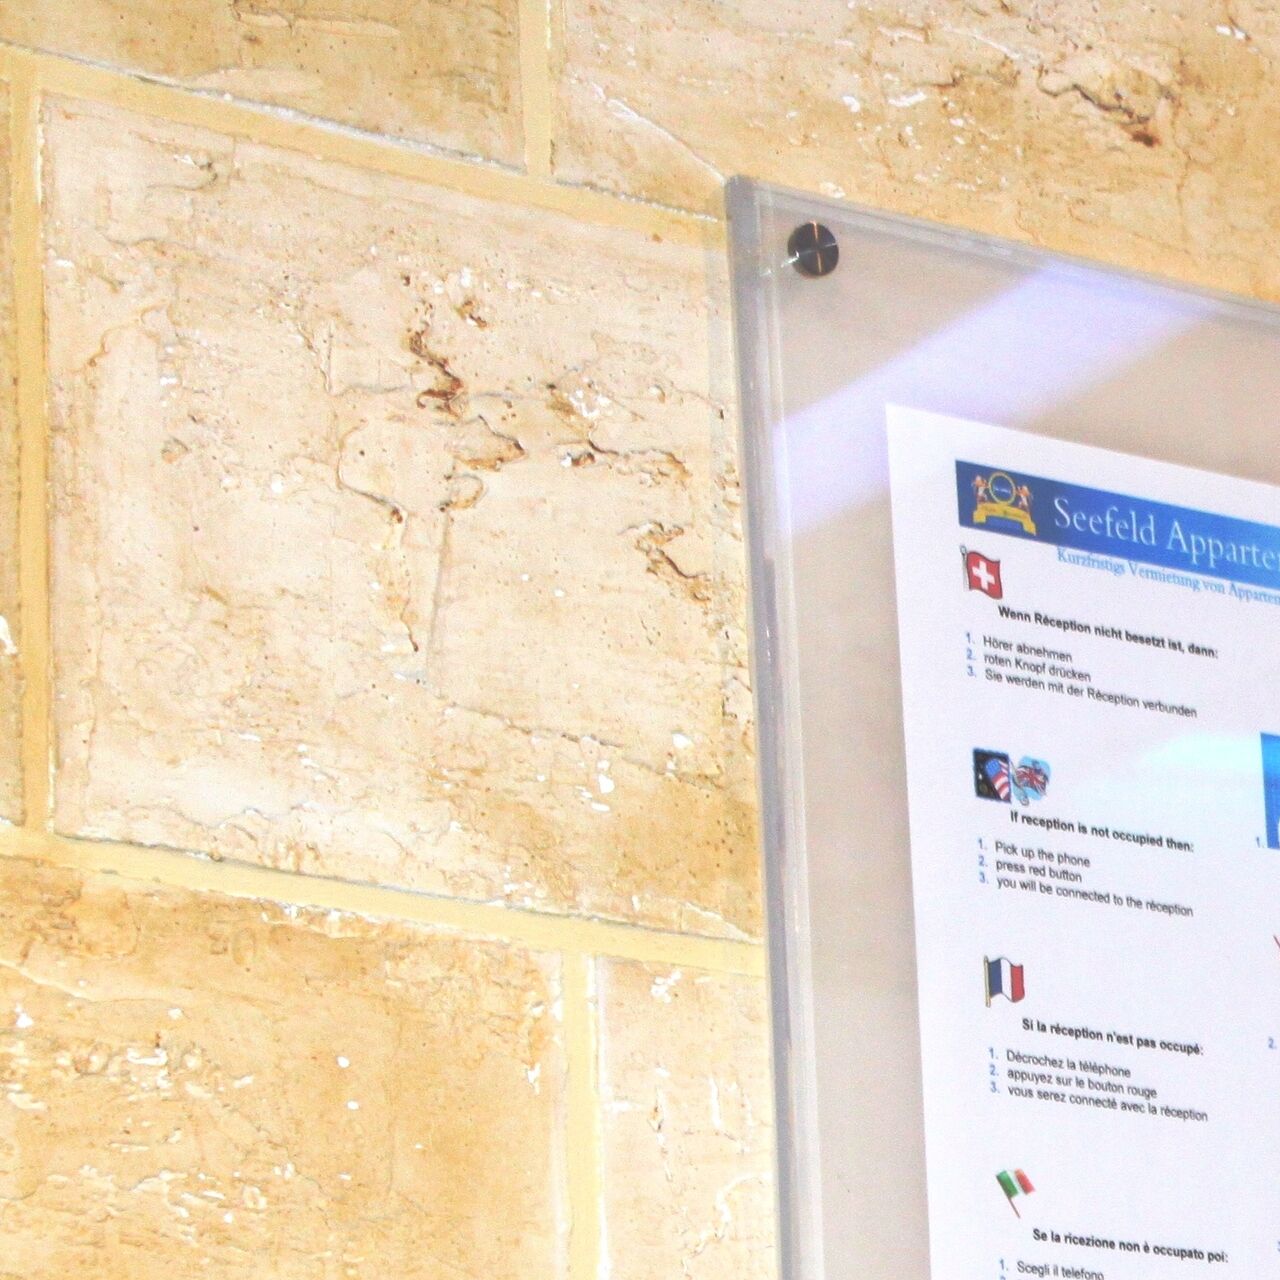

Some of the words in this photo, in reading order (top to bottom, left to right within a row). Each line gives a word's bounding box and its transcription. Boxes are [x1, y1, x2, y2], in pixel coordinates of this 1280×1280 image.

[1054, 496, 1156, 546] Seefeld
[966, 632, 975, 645] 1.
[983, 635, 1013, 652] Hörer
[1017, 642, 1072, 663] abnehmen
[998, 606, 1031, 623] Wenn
[1095, 626, 1123, 640] nicht
[1125, 631, 1165, 649] besetzt
[1168, 640, 1185, 653] ist,
[1188, 643, 1219, 659] dann:
[966, 649, 976, 661] 2.
[984, 654, 1012, 668] roten
[1015, 658, 1046, 676] Knopf
[1048, 665, 1091, 683] drücken
[967, 666, 976, 678] 3.
[985, 669, 1003, 683] Sie
[1006, 675, 1045, 690] werden
[1048, 682, 1064, 694] mit
[1067, 685, 1084, 698] der
[1142, 700, 1198, 719] verbunden
[1011, 811, 1018, 823] If
[1021, 815, 1074, 833] reception
[1077, 822, 1088, 835] is
[1091, 826, 1109, 838] not
[1112, 829, 1163, 847] occupied
[1166, 838, 1194, 853] then:
[978, 838, 987, 850] 1.
[995, 841, 1018, 856] Pick
[1021, 846, 1035, 859] up
[1038, 847, 1054, 862] the
[1057, 851, 1091, 868] phone
[978, 856, 988, 867] 2.
[996, 859, 1026, 873] press
[1029, 863, 1046, 877] red
[1050, 866, 1083, 883] button
[979, 873, 989, 884] 3.
[997, 877, 1017, 890] you
[1019, 878, 1037, 892] will
[1039, 882, 1053, 895] be
[1056, 887, 1110, 904] connected
[1113, 895, 1124, 906] to
[1126, 896, 1142, 909] the
[1022, 1018, 1034, 1031] Si
[1037, 1021, 1047, 1033] la
[1050, 1023, 1103, 1041] réception
[1106, 1031, 1134, 1046] n'est
[1136, 1037, 1156, 1049] pas
[1159, 1041, 1204, 1056] occupé:
[988, 1047, 998, 1060] 1.
[1006, 1049, 1063, 1069] Décrochez
[1066, 1058, 1076, 1070] la
[1079, 1061, 1131, 1078] téléphone
[989, 1064, 999, 1076] 2.
[1007, 1069, 1052, 1085] appuyez
[1055, 1075, 1072, 1087] sur
[1075, 1076, 1085, 1088] le
[1088, 1078, 1124, 1094] bouton
[1127, 1086, 1157, 1100] rouge
[990, 1082, 1000, 1093] 3.
[1008, 1085, 1034, 1099] vous
[1037, 1090, 1066, 1103] serez
[1120, 1102, 1145, 1114] avec
[1148, 1103, 1157, 1115] la
[1032, 1228, 1047, 1241] Se
[1051, 1231, 1061, 1243] la
[1064, 1232, 1116, 1250] ricezione
[1119, 1241, 1140, 1253] non
[1153, 1245, 1205, 1261] occupato
[1207, 1251, 1229, 1264] poi:
[999, 1259, 1009, 1272] 1.
[1017, 1260, 1050, 1278] Scegli
[1053, 1264, 1059, 1276] il
